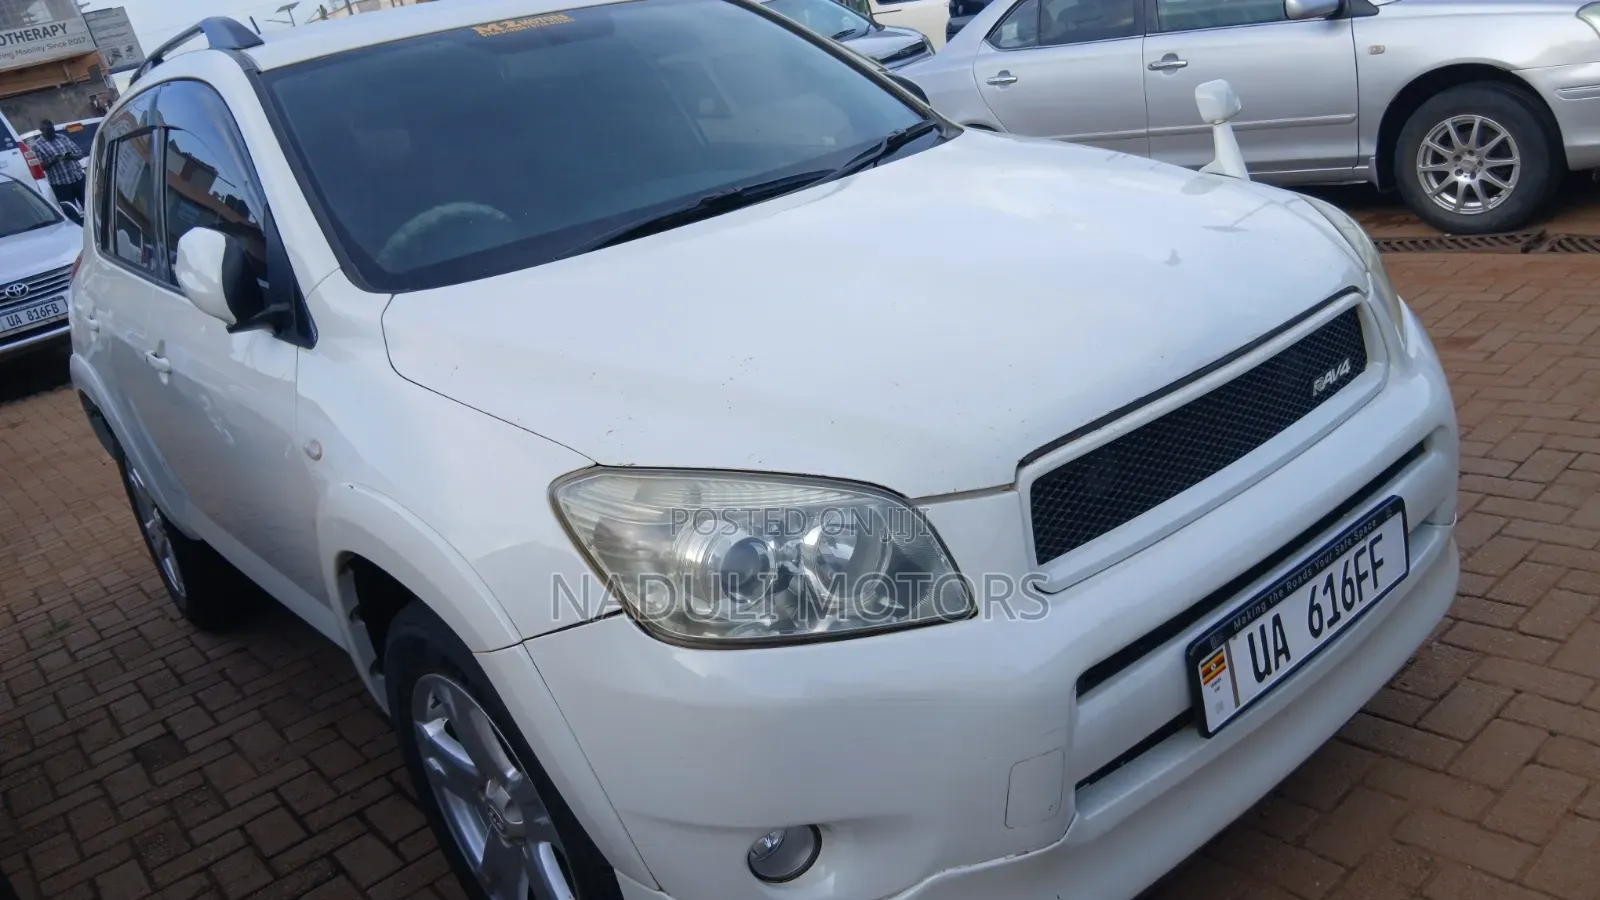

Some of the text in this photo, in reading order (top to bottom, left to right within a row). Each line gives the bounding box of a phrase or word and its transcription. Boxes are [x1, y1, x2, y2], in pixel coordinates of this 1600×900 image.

[15, 44, 45, 56] Mobility
[47, 41, 67, 50] Since
[68, 36, 86, 46] 2017
[6, 313, 22, 327] UA
[26, 302, 59, 321] 816FB
[1312, 357, 1351, 397] RAV4
[1233, 518, 1377, 631] Making the Roads Your Safe Space
[1246, 532, 1385, 683] UA 616FF
